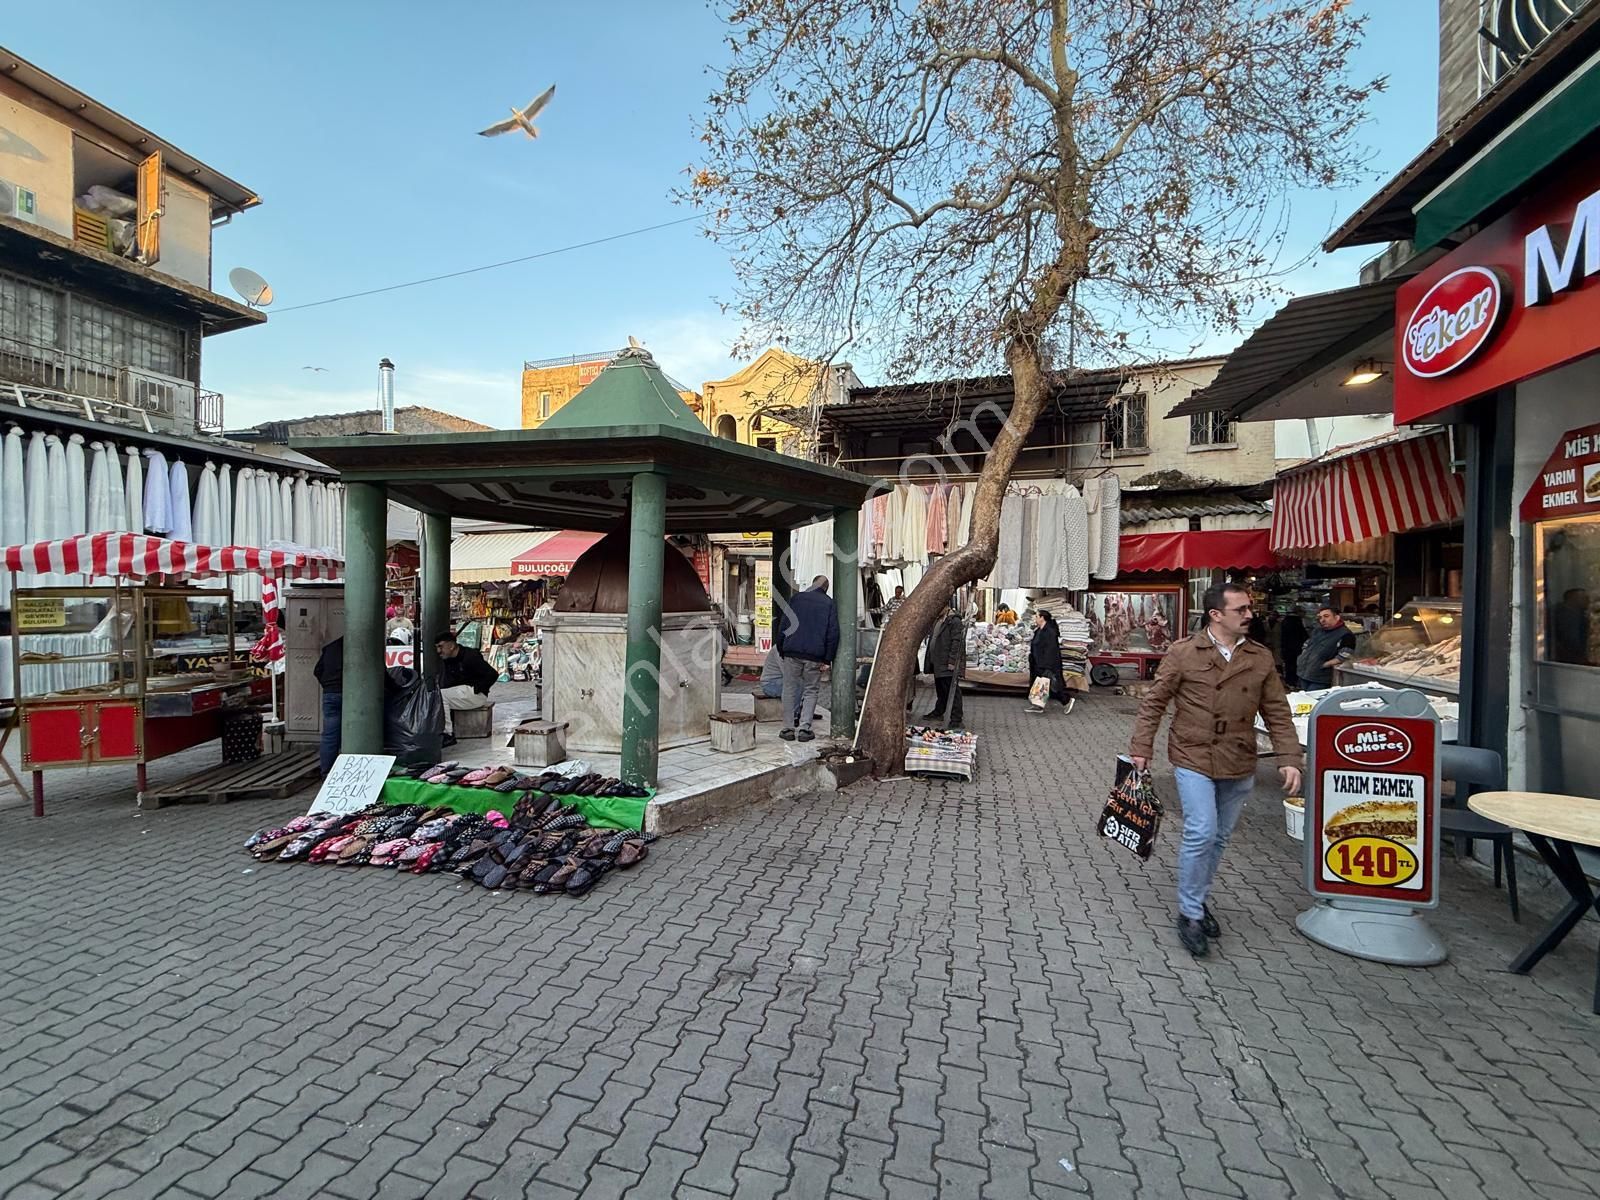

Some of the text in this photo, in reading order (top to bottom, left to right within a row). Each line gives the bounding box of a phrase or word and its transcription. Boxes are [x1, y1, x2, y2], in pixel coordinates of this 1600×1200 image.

[1565, 434, 1590, 459] MİS
[1543, 469, 1576, 487] YARIM
[1543, 490, 1578, 508] EKMEK
[518, 562, 572, 574] BULUÇOĞL
[184, 654, 245, 669] YASTK
[1357, 730, 1387, 744] Mis
[1344, 742, 1404, 753] Kokoreç
[343, 755, 374, 770] BAY
[328, 769, 375, 785] BAYAN
[1333, 775, 1414, 798] YARIM EKMEK
[1120, 824, 1140, 843] SIFIR
[1117, 834, 1139, 853] ATIK
[1337, 844, 1412, 878] 140 TL
